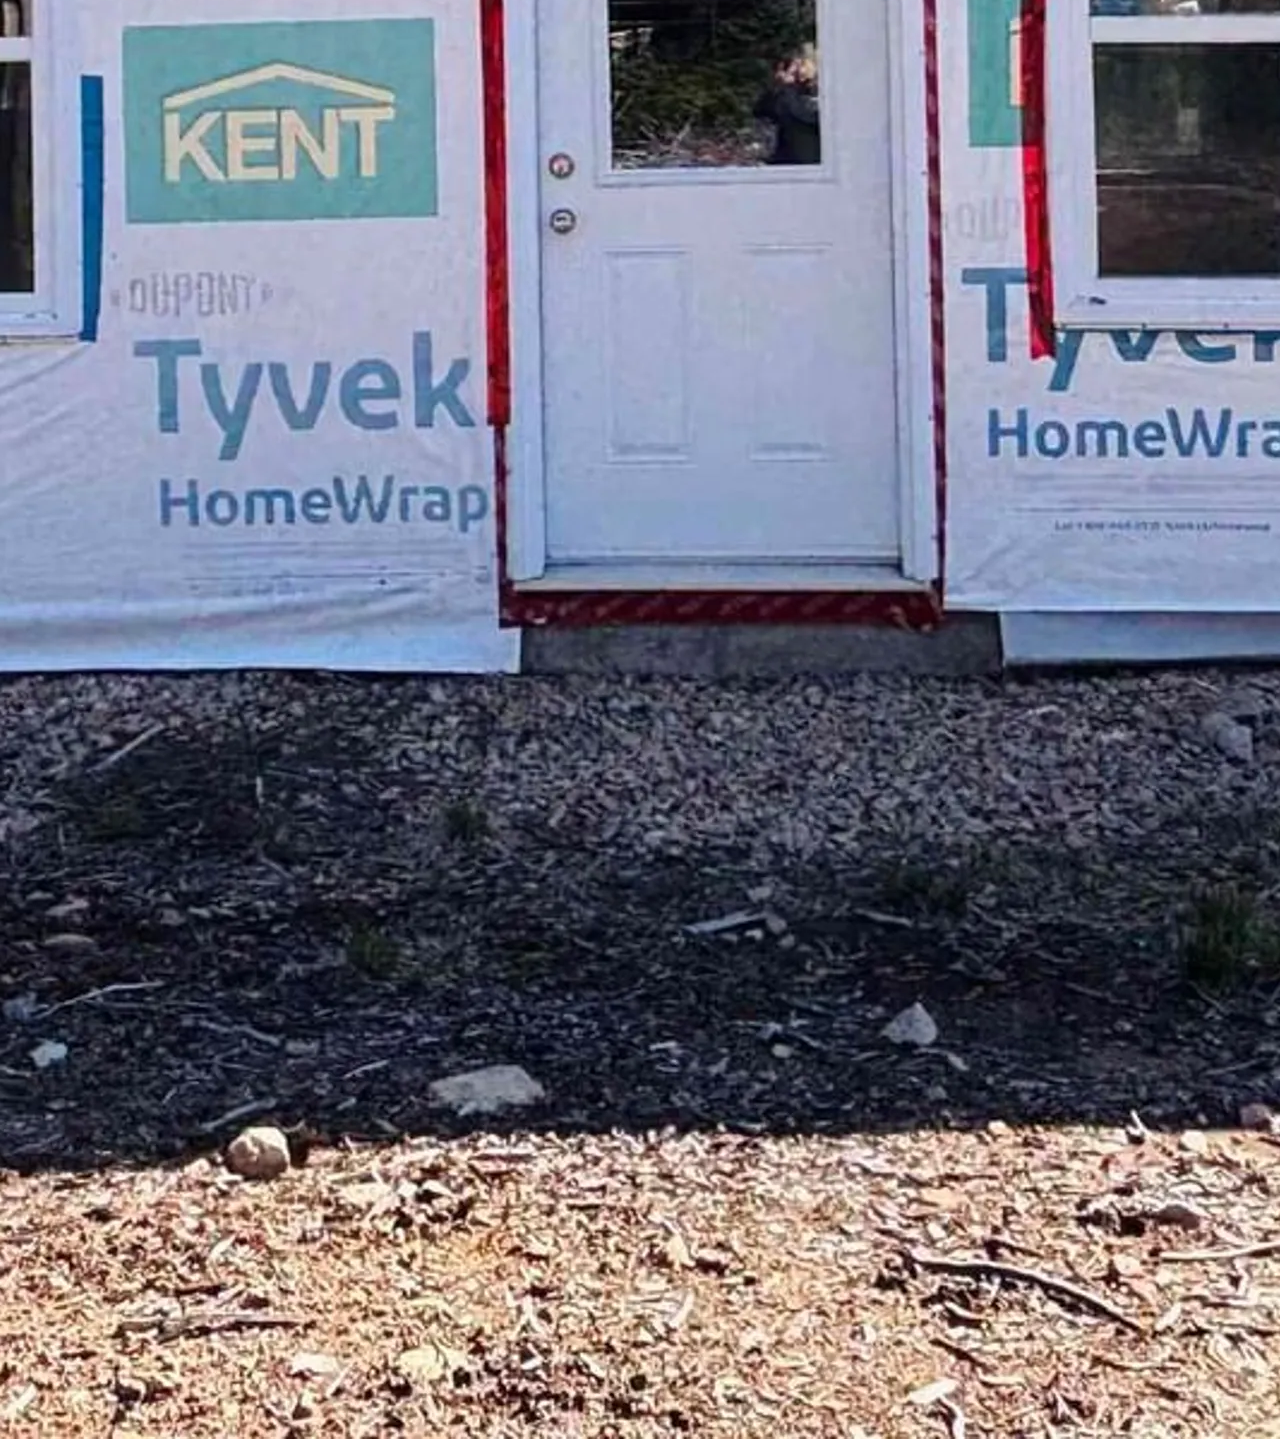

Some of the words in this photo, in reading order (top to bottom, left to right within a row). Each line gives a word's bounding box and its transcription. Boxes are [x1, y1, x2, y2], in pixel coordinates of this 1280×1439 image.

[162, 105, 395, 183] KENT
[127, 272, 259, 318] DUPONT
[132, 330, 476, 462] Tyvek
[158, 474, 490, 533] HomeWrap
